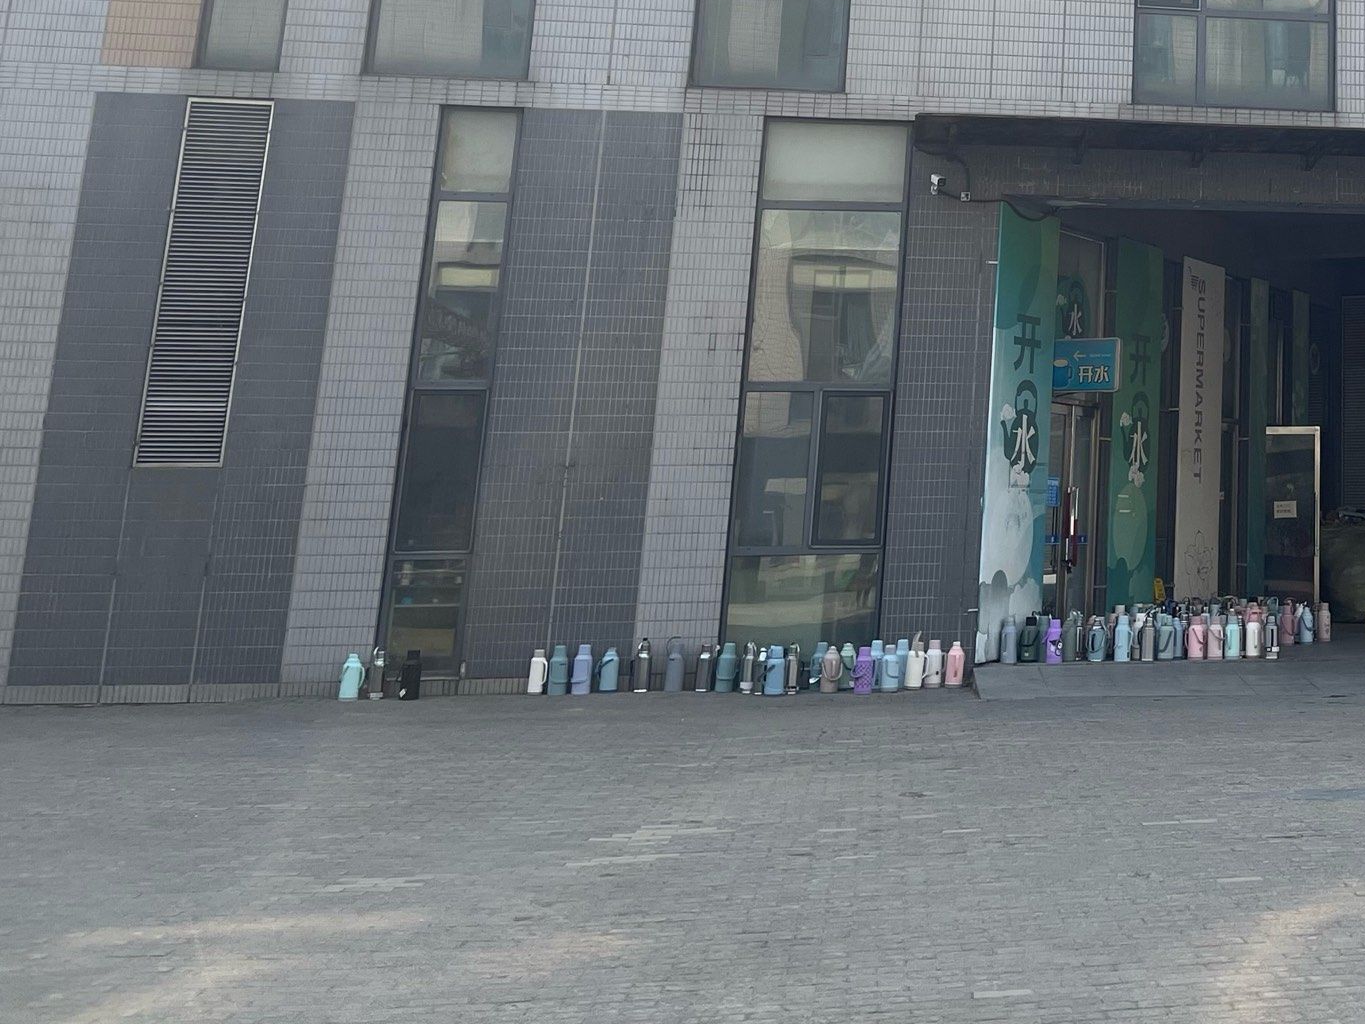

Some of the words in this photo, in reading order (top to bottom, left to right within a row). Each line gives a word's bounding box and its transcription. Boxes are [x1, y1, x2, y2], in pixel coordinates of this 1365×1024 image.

[1067, 303, 1084, 336] 水
[1078, 365, 1110, 384] 开水
[1193, 278, 1206, 483] SUPERMARKET
